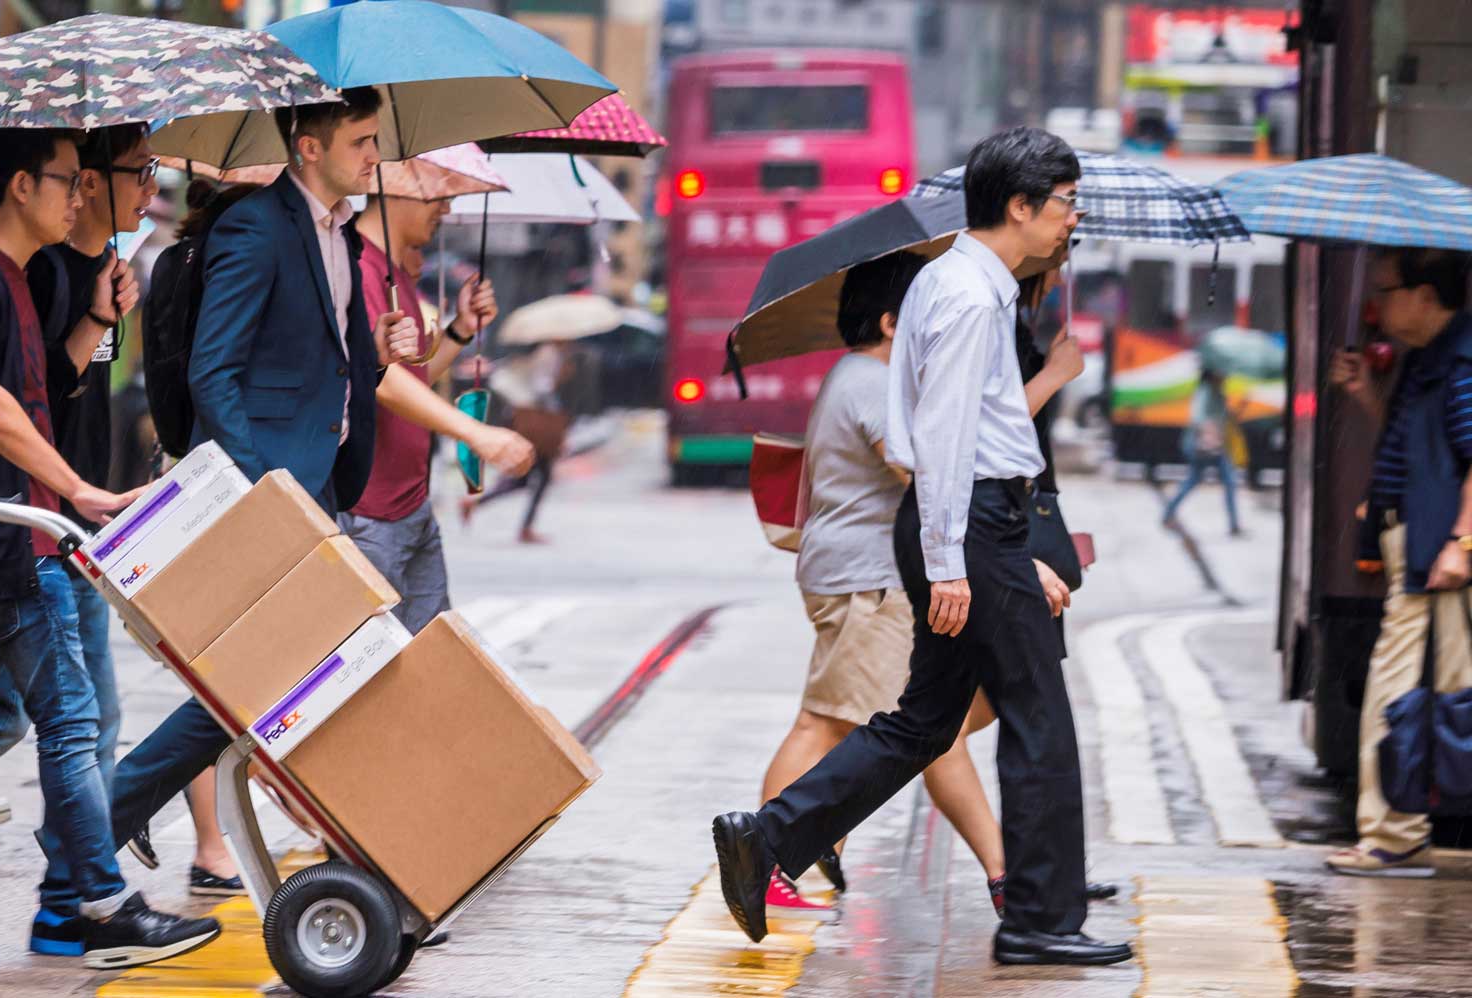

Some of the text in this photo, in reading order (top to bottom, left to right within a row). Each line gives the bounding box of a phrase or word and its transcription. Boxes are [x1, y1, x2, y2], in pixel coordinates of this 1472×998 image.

[181, 489, 234, 533] Medium Box
[120, 562, 149, 588] FedEx
[336, 639, 385, 683] Large Box
[263, 710, 302, 745] FedEx
